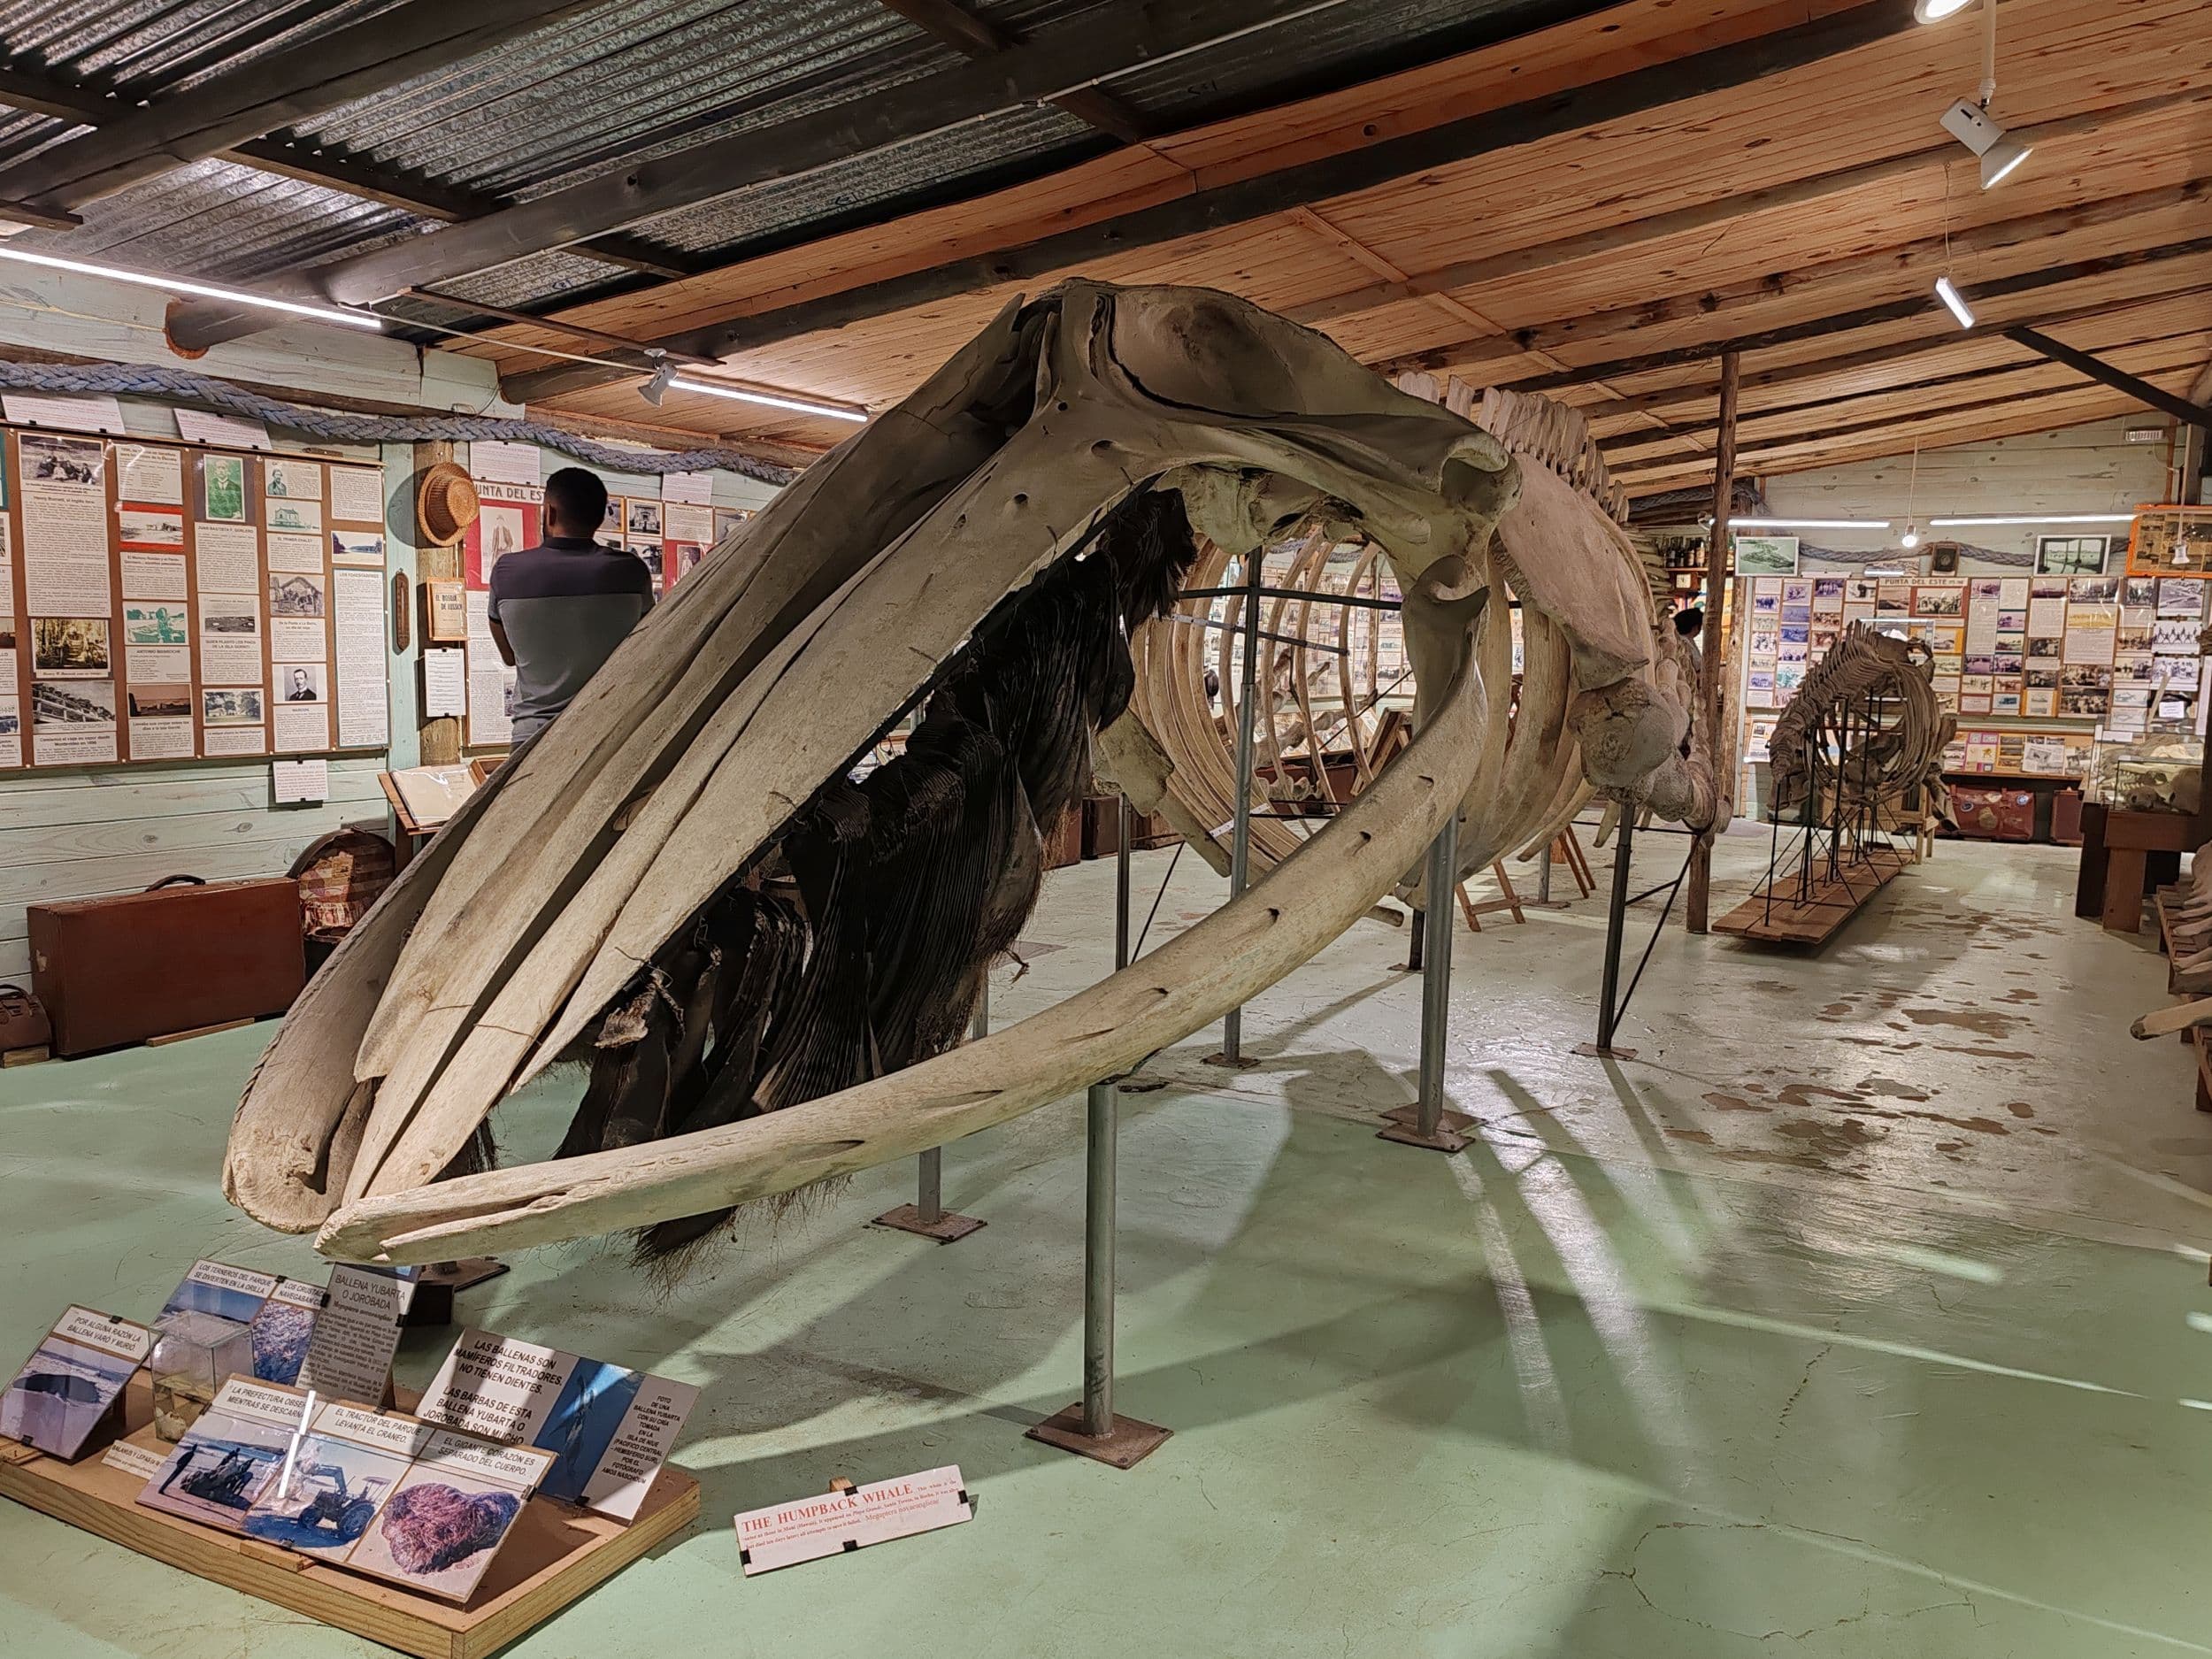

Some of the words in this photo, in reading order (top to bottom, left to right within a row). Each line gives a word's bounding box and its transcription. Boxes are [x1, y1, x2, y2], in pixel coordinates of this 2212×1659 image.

[475, 484, 503, 497] UNTA
[507, 488, 526, 499] DEL
[531, 490, 545, 500] ES
[199, 1263, 211, 1272] LOS
[212, 1265, 237, 1279] TERNEROS
[250, 1276, 273, 1287] PARQUE
[202, 1274, 228, 1285] DIVIERTEN
[245, 1285, 265, 1294] ORILLA
[278, 1290, 312, 1305] NAVEGABAN
[296, 1285, 325, 1297] CRUSTAC
[335, 1275, 369, 1290] BALLENA
[372, 1283, 405, 1300] YUBARTA
[342, 1290, 349, 1299] O
[349, 1292, 390, 1310] JOROBADA
[66, 1325, 94, 1338] BALLENA
[74, 1317, 87, 1326] POR
[88, 1320, 111, 1333] ALGUNA
[112, 1328, 133, 1340] RAZÓN
[455, 1348, 503, 1369] MAMÍFEROS
[503, 1361, 563, 1386] FILTRADORES.
[474, 1340, 491, 1353] LAS
[492, 1344, 537, 1363] BALLENAS
[537, 1357, 557, 1370] SON
[459, 1363, 474, 1374] NO
[474, 1367, 504, 1383] TIENEN
[504, 1376, 542, 1394] DIENTES.
[227, 1395, 258, 1410] MIENTRAS
[259, 1402, 270, 1411] SE
[269, 1405, 303, 1417] DESCARN
[232, 1386, 242, 1395] LA
[242, 1388, 283, 1403] PREFECTURA
[284, 1398, 316, 1410] OBSER
[443, 1386, 461, 1399] LAS
[461, 1391, 495, 1409] BARBAS
[495, 1402, 510, 1412] DE
[511, 1405, 533, 1419] ESTA
[334, 1408, 344, 1417] EL
[345, 1410, 376, 1424] TRACTOR
[376, 1417, 390, 1428] DEL
[390, 1421, 423, 1436] PARQUE
[436, 1398, 475, 1417] BALLENA
[478, 1409, 516, 1429] YUBARTA
[518, 1422, 526, 1432] O
[634, 1405, 657, 1414] BALLENA
[657, 1410, 680, 1422] YUBARTA
[334, 1418, 365, 1434] LEVANTA
[365, 1425, 376, 1434] EL
[423, 1409, 470, 1429] JOROBADA
[472, 1423, 490, 1435] SON
[491, 1429, 525, 1444] MUCHO
[640, 1422, 660, 1432] TOMADA
[437, 1447, 478, 1464] SEPARADO
[478, 1456, 493, 1467] DEL
[493, 1461, 526, 1477] CUERPO.
[443, 1436, 453, 1446] EL
[451, 1439, 487, 1455] GIGANTE
[487, 1446, 524, 1464] CORAZÓN
[524, 1456, 535, 1467] ES
[742, 1516, 772, 1532] THE
[778, 1496, 857, 1524] HUMPBACK
[863, 1484, 913, 1503] WHALE
